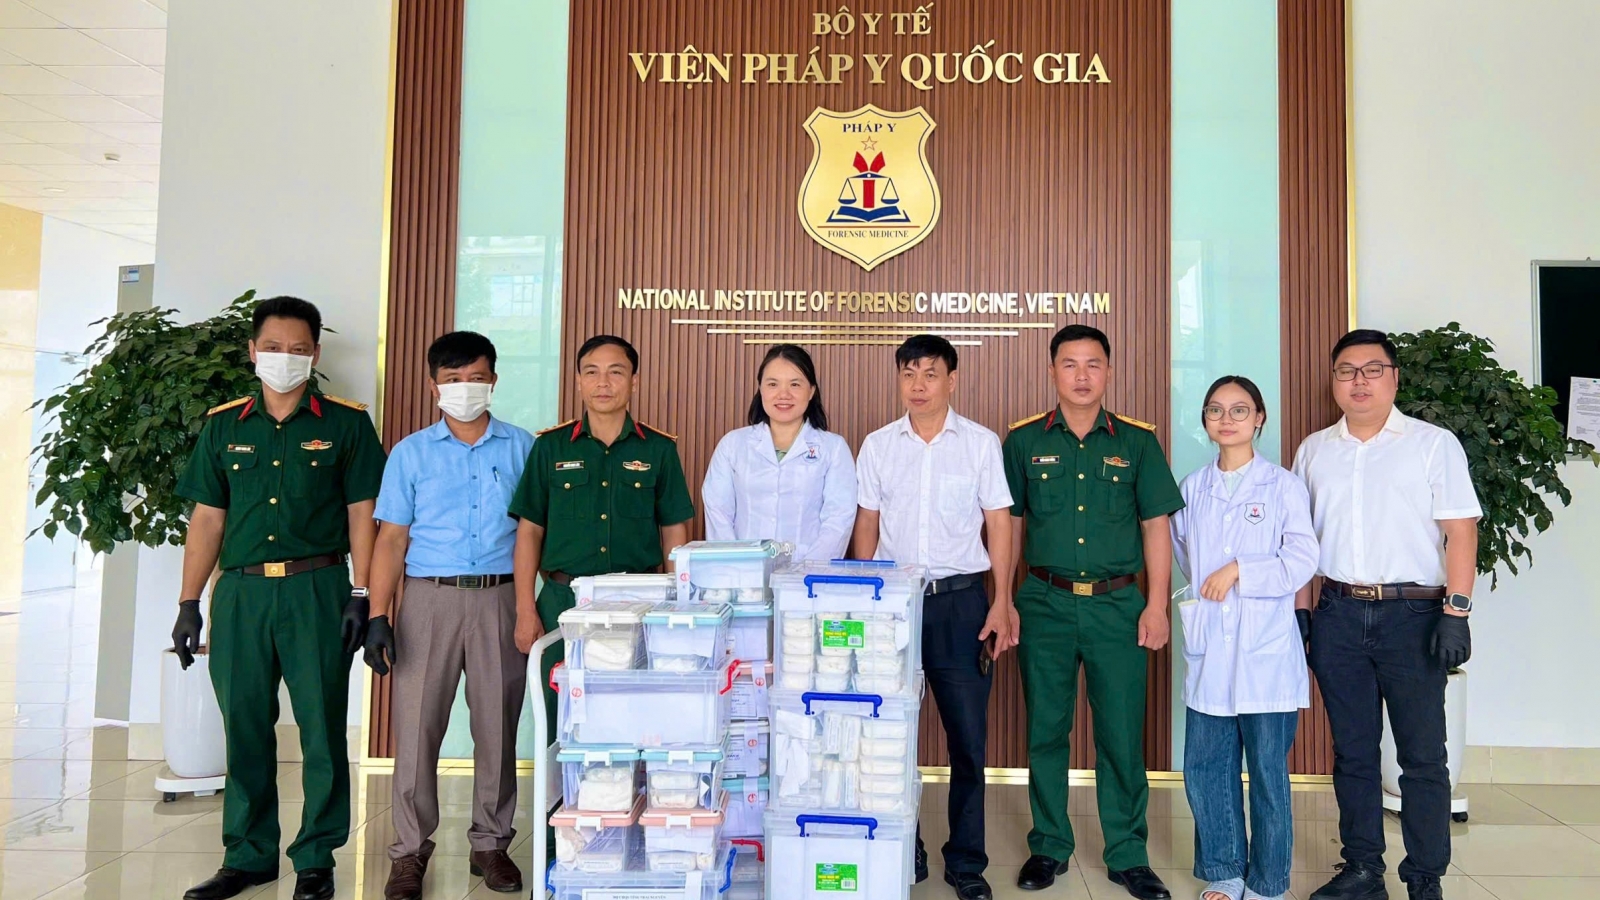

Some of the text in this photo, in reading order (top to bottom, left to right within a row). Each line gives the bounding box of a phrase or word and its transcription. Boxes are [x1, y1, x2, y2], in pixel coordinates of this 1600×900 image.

[812, 2, 934, 40] BỘ Y TẾ
[628, 39, 1111, 90] VIỆN PHÁP Y QUỐC GIA
[843, 120, 897, 133] PHÁP Y
[828, 230, 909, 238] FORENSIC MEDICINE
[618, 288, 1110, 317] NATIONAL INSTITUTE OF FORENSIC MEDICINE, VIETNAM
